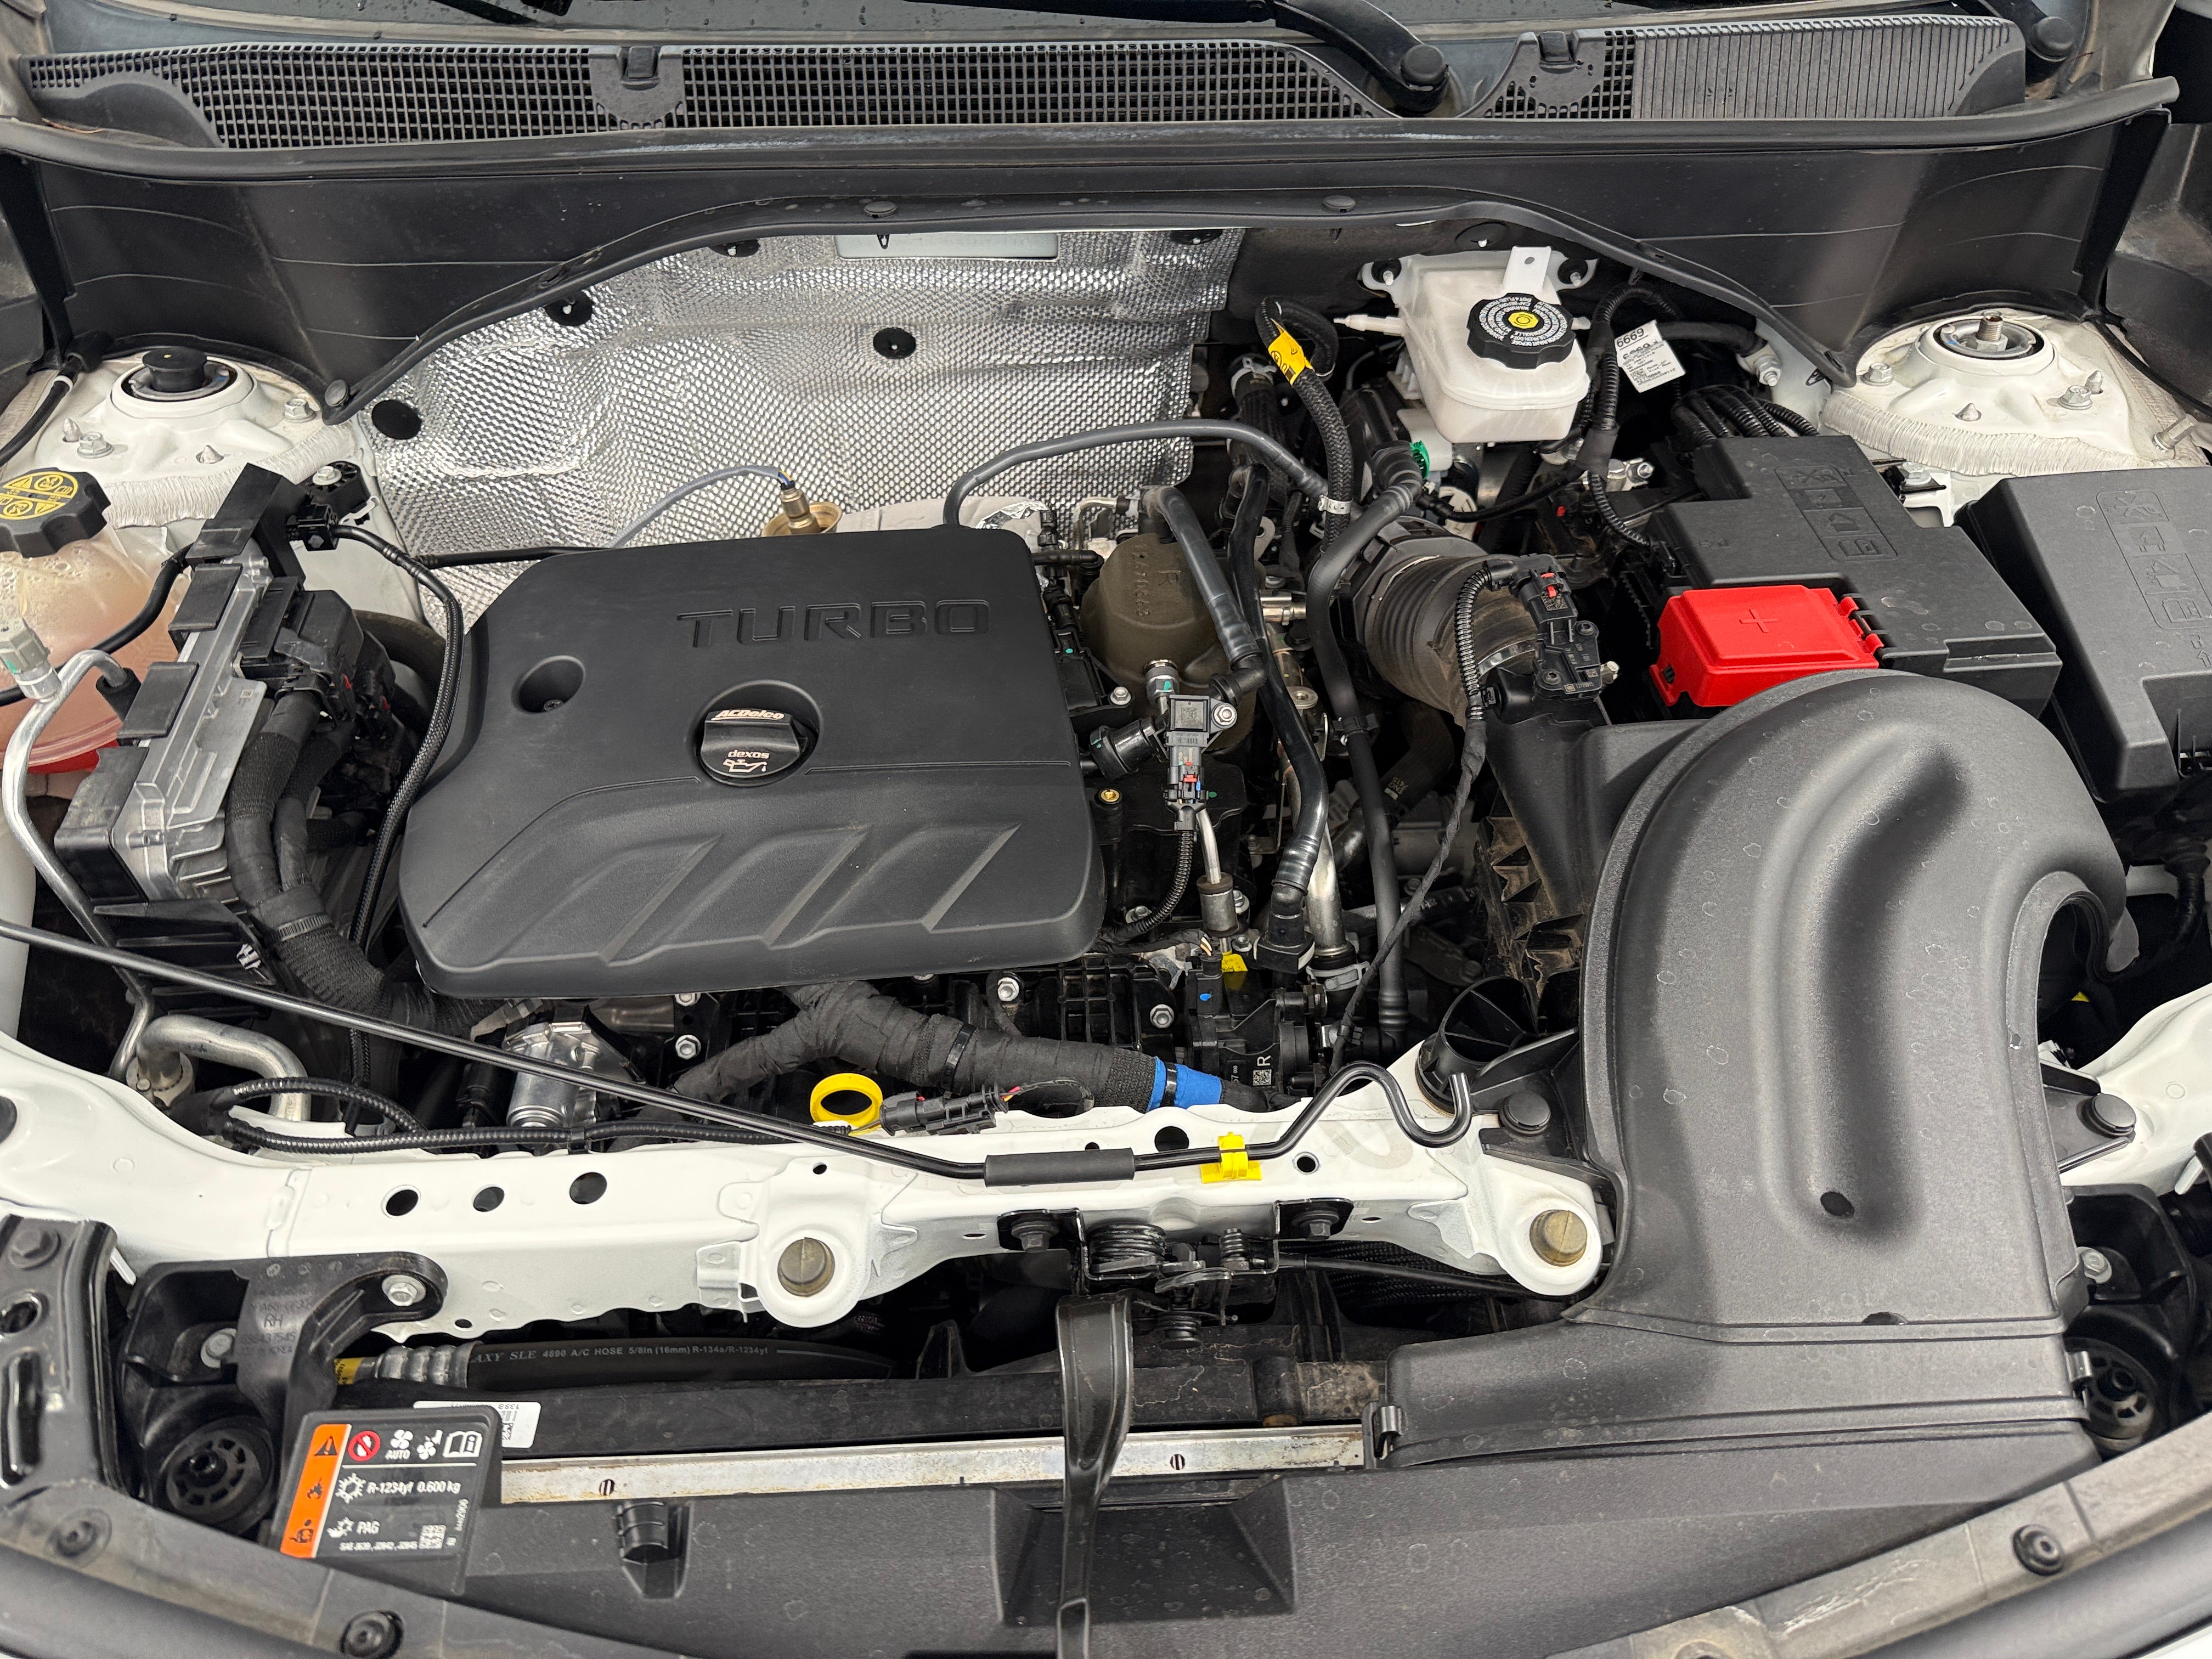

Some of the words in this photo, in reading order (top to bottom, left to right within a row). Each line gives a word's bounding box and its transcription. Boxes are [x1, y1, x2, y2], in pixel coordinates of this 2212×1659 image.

[1616, 328, 1644, 347] 6669
[677, 599, 990, 647] TURBO
[715, 709, 785, 720] ACDelco
[727, 749, 770, 759] dexos
[1256, 1055, 1271, 1066] R
[263, 1313, 283, 1328] RH
[510, 1350, 537, 1361] SLE
[571, 1348, 590, 1357] A/C
[594, 1347, 623, 1356] HOSE
[656, 1346, 690, 1355] (16mm)
[385, 1449, 411, 1460] AUTO
[366, 1481, 415, 1496] R-1234yf
[416, 1481, 446, 1494] 0.600
[447, 1481, 461, 1494] kg
[357, 1521, 381, 1534] PAG
